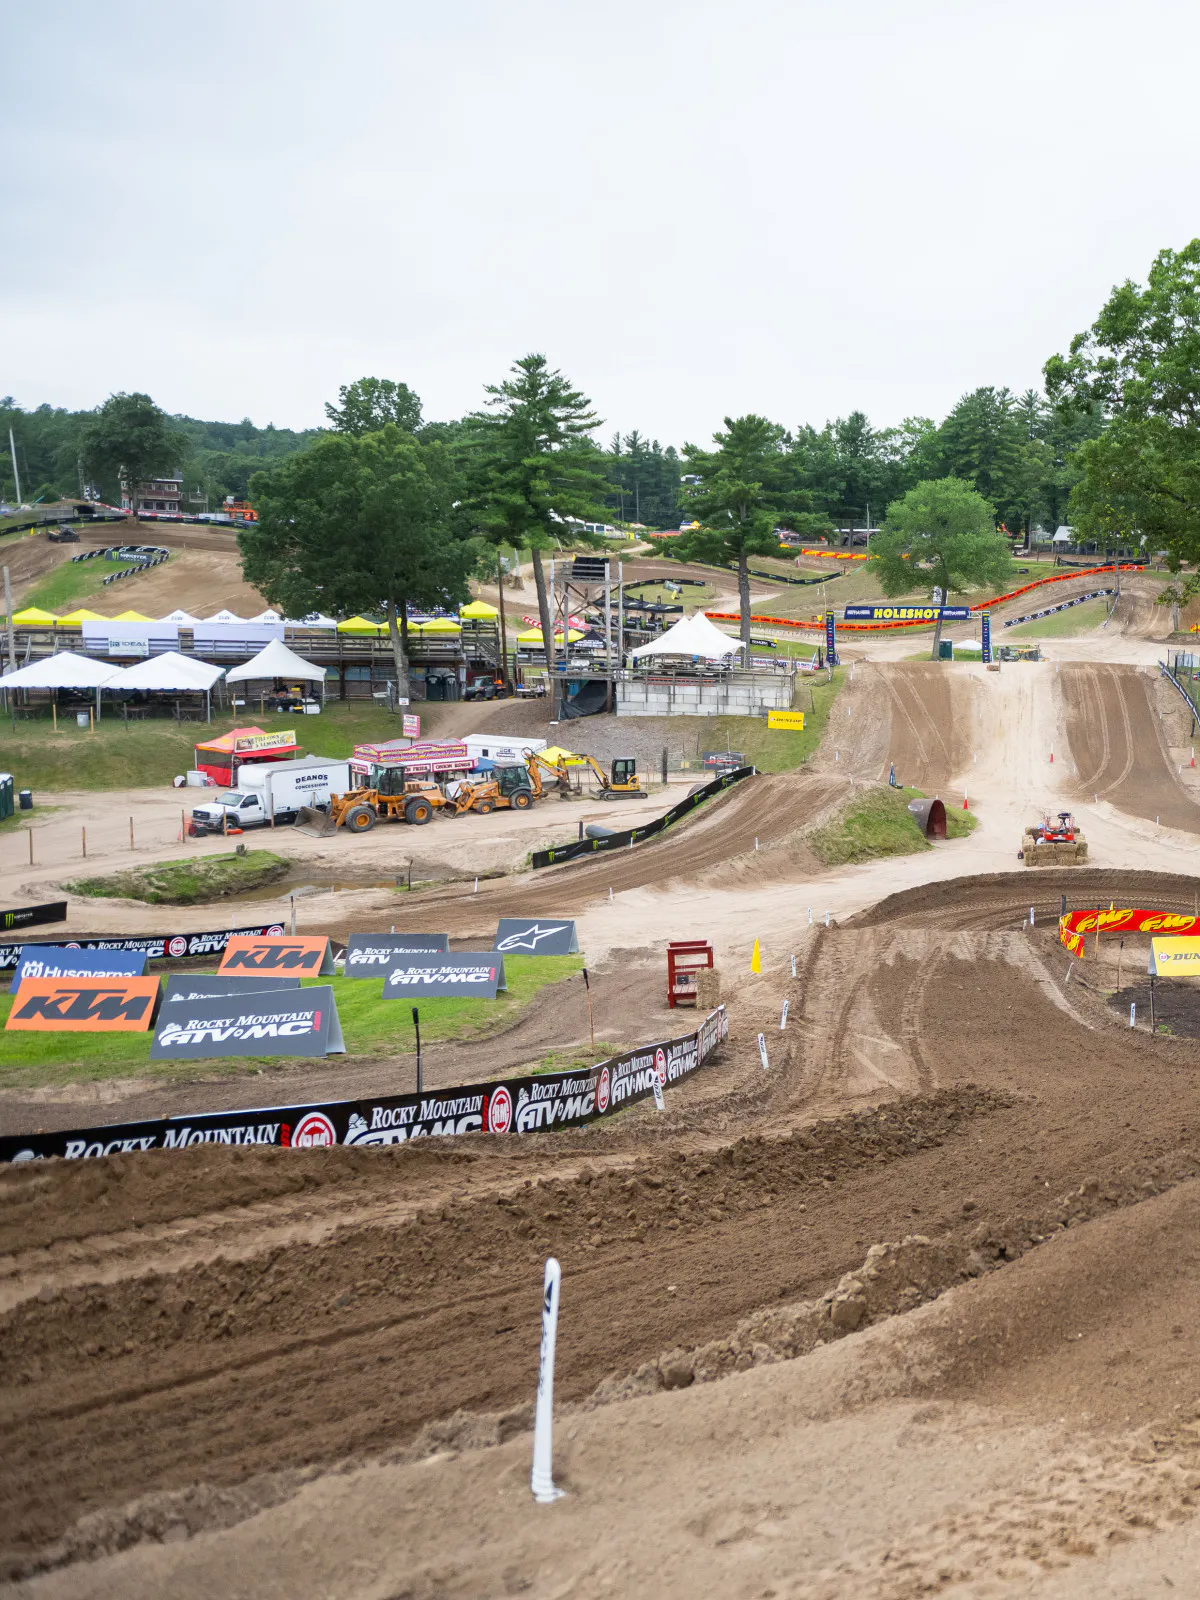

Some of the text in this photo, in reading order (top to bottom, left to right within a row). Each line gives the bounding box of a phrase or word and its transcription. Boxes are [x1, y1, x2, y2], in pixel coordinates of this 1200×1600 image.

[873, 608, 940, 619] HOLESHOT
[295, 782, 328, 790] CONCESSIONS
[1077, 909, 1133, 933] FMF
[1141, 915, 1195, 931] FMF
[98, 940, 165, 950] ROCKY MOUNTAIN
[201, 932, 225, 942] ROCKY
[223, 945, 322, 968] KTM
[365, 947, 392, 955] ROCKY
[44, 966, 133, 978] Husqvarna
[441, 966, 490, 974] MOUNTAIN
[13, 989, 152, 1020] KTM
[186, 1010, 314, 1030] ROCKY MOUNTAIN
[618, 1054, 654, 1078] ROCKY MOUNTAIN
[531, 1083, 561, 1100] ROCKY
[559, 1075, 598, 1097] MOUNTAIN
[370, 1094, 484, 1130] ROCKY MOUNTAIN
[65, 1135, 156, 1160] ROCKY
[163, 1123, 281, 1149] MOUNTAIN
